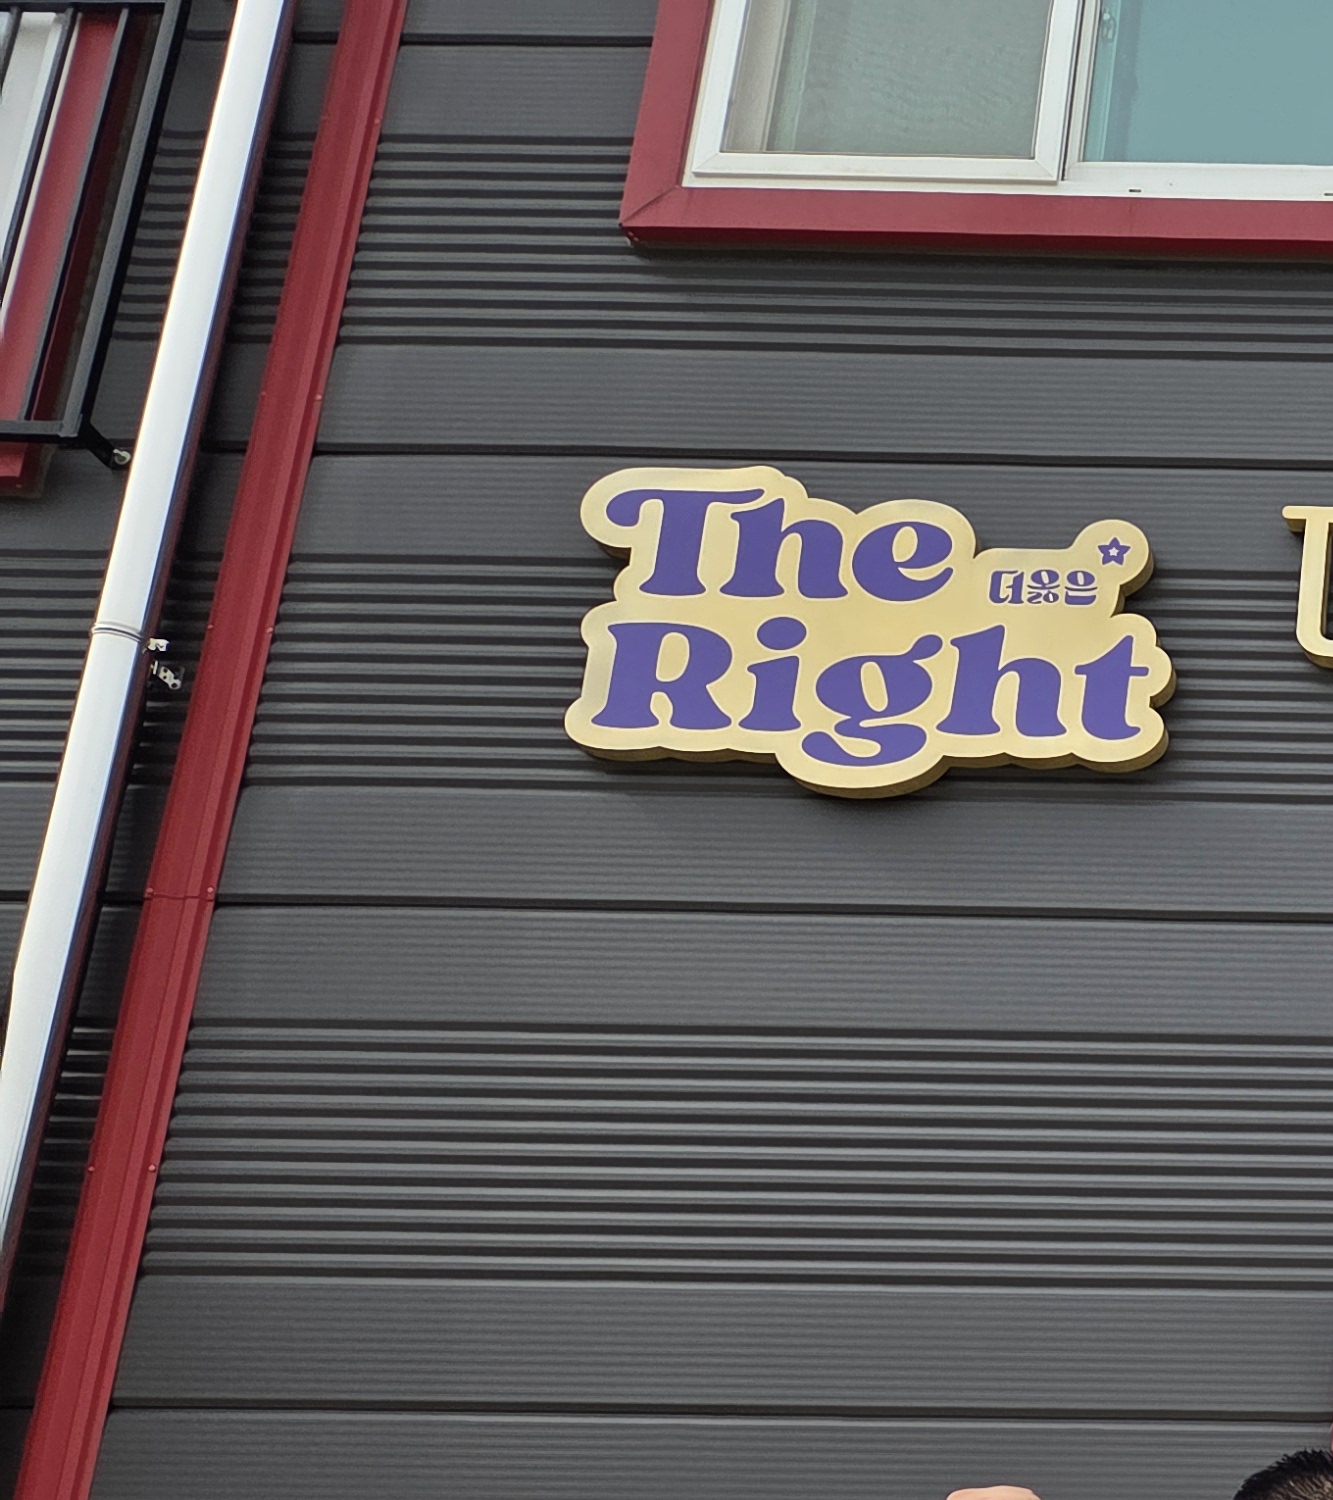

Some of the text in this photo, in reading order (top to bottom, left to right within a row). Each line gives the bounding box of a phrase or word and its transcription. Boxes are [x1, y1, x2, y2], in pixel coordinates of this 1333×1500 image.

[605, 487, 955, 603] The
[988, 568, 1098, 606] 더옳은
[590, 616, 1150, 767] Right
